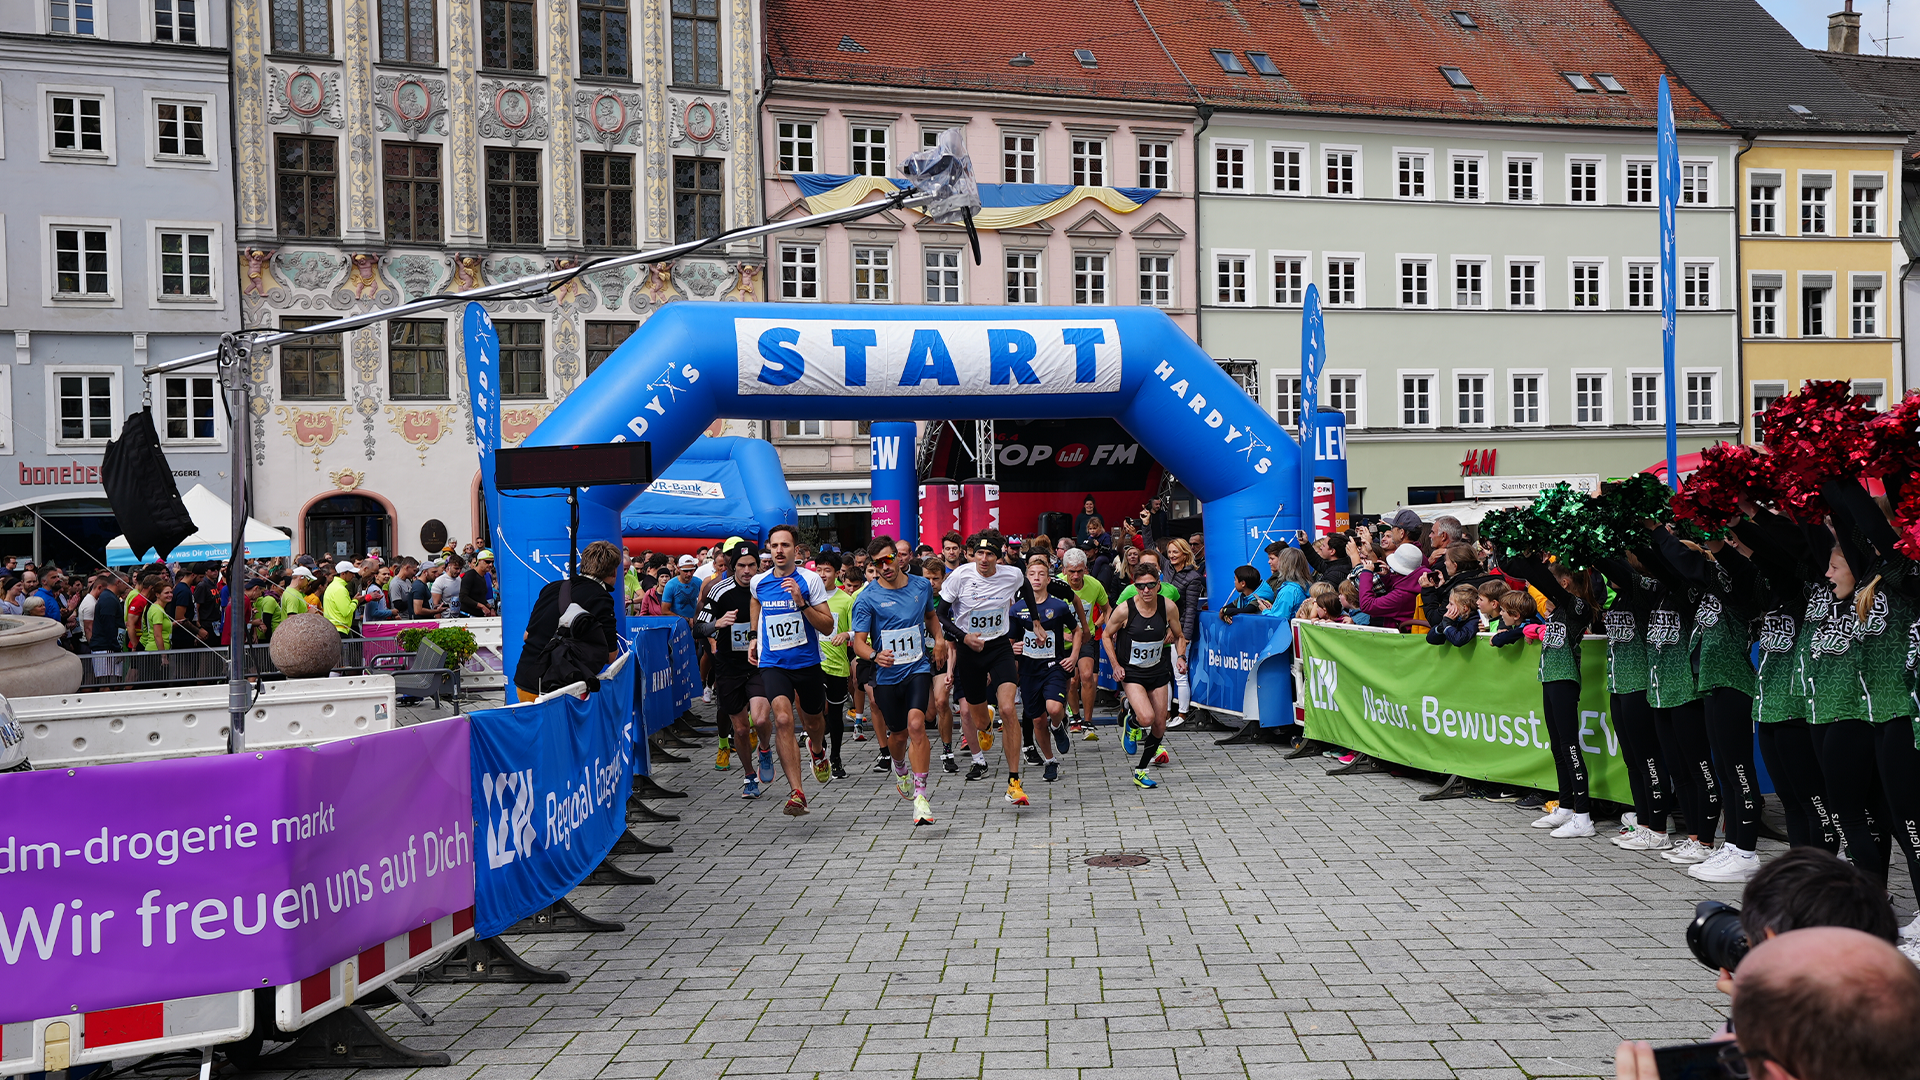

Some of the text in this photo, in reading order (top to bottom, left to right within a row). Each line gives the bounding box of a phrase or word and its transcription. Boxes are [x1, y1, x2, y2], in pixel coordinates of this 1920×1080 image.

[757, 327, 1105, 386] START
[985, 443, 1139, 466] TOP FM
[1460, 448, 1498, 476] H&M
[651, 481, 702, 493] VR-Bank
[192, 549, 203, 557] Dir
[769, 620, 800, 638] 1027
[971, 614, 1002, 628] 9318
[889, 636, 914, 652] 111
[1024, 637, 1053, 649] 936
[1133, 646, 1161, 660] 9311
[1208, 649, 1260, 671] Bei uns läuf
[1361, 685, 1549, 750] Natur. Bewusst.
[0, 801, 336, 874] dm-drogerie markt
[0, 821, 469, 965] Wir freuen uns auf Dich
